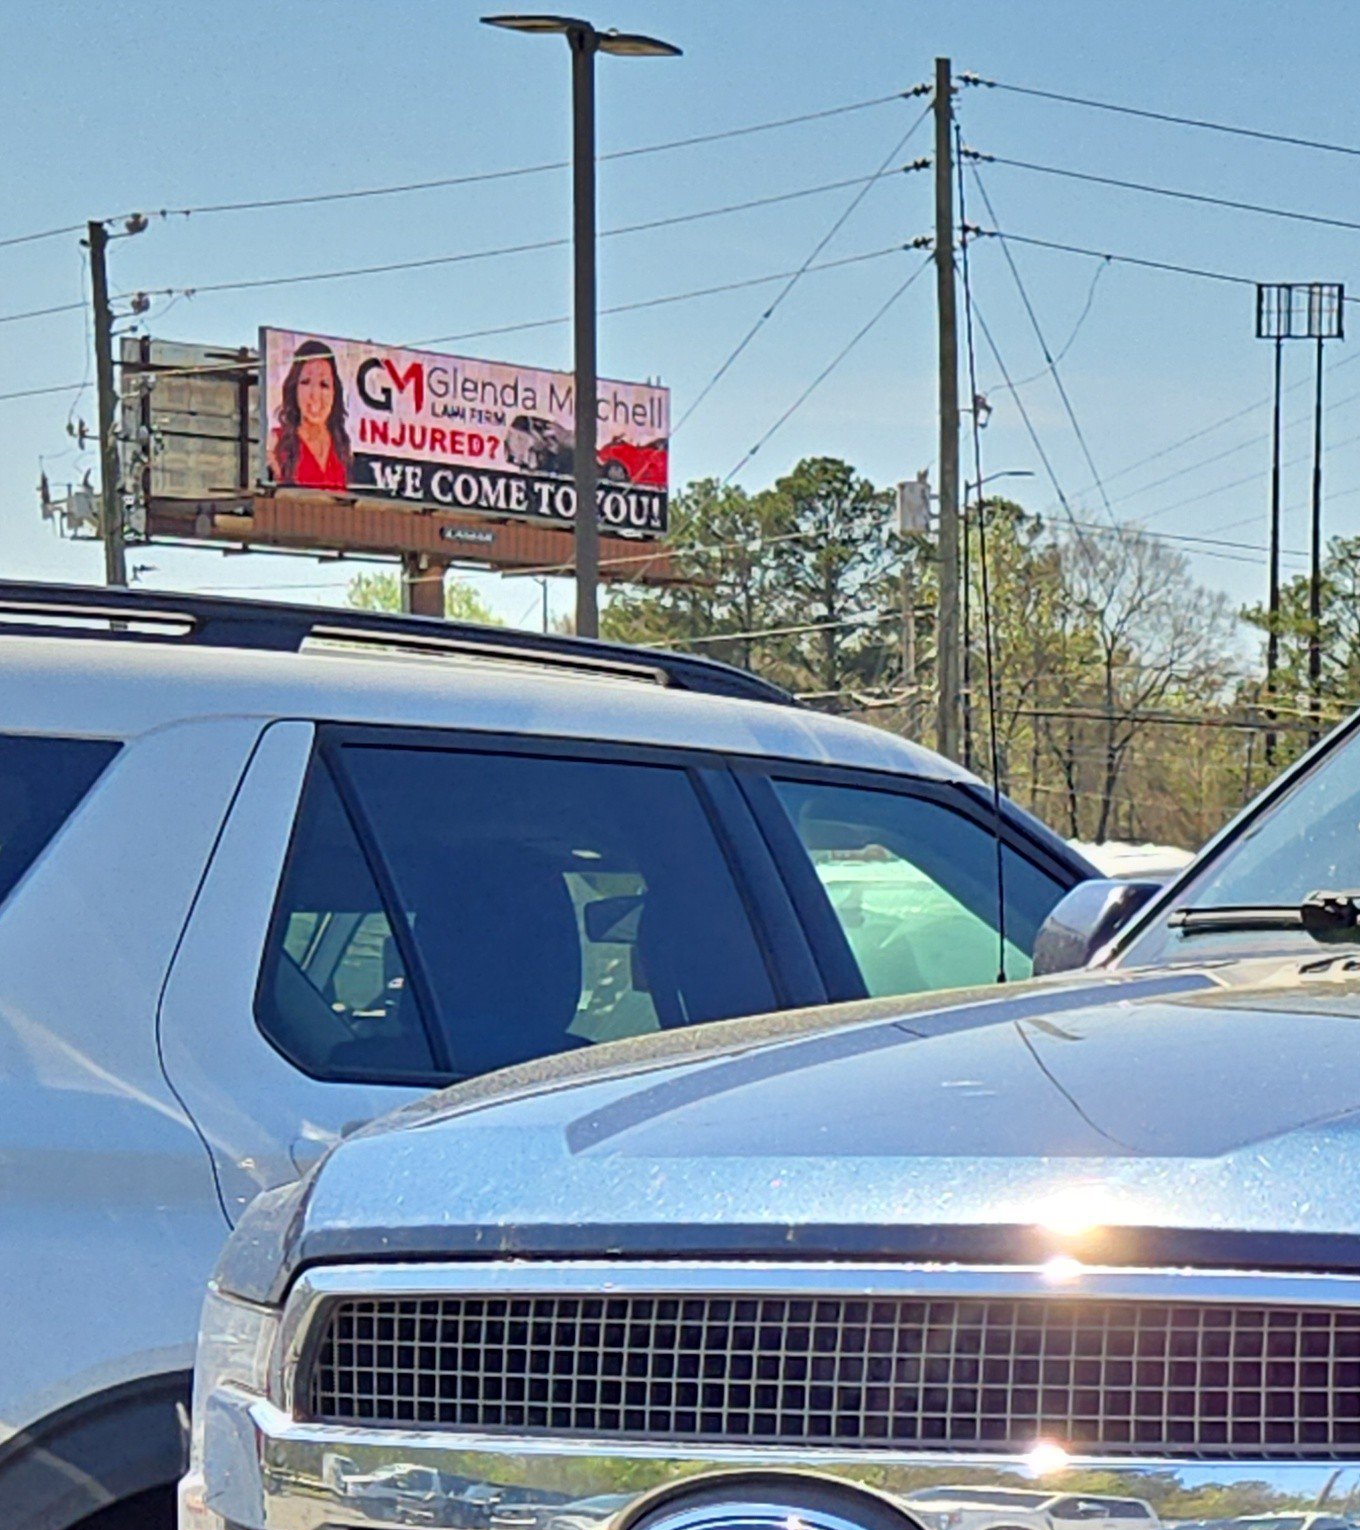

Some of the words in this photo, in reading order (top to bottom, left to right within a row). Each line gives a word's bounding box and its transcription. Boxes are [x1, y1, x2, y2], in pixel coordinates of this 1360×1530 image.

[357, 357, 424, 414] GM
[427, 366, 537, 410] Glenda
[549, 383, 663, 429] Mchell
[359, 417, 500, 460] INJURED?
[369, 461, 424, 499] WE
[430, 469, 528, 512] COME
[534, 481, 578, 518] TO
[595, 489, 662, 528] OU!
